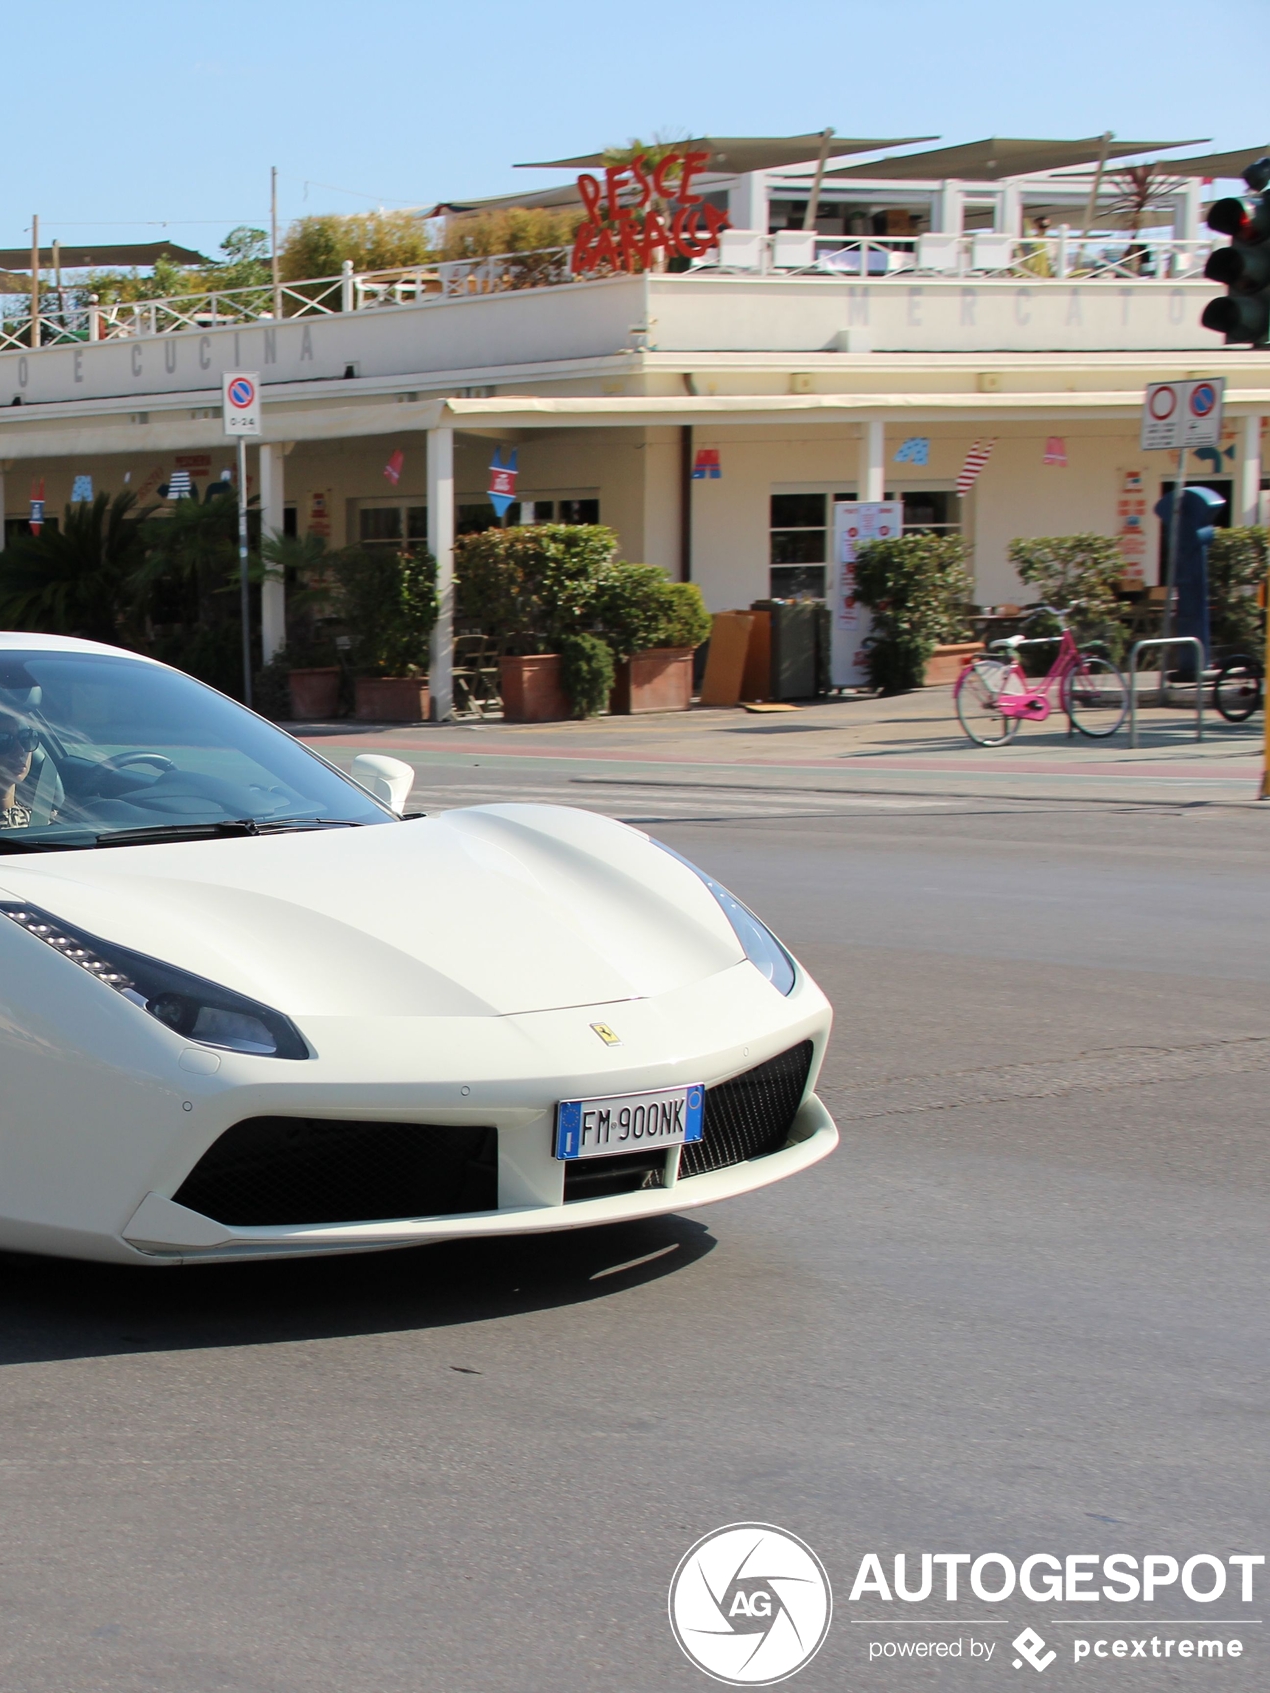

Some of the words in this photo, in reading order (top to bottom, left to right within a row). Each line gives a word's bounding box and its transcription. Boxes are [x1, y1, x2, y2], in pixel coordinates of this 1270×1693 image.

[578, 152, 710, 228] PESCE
[847, 286, 1187, 327] MERCATO
[74, 350, 84, 383] E
[131, 324, 314, 378] CUCINA
